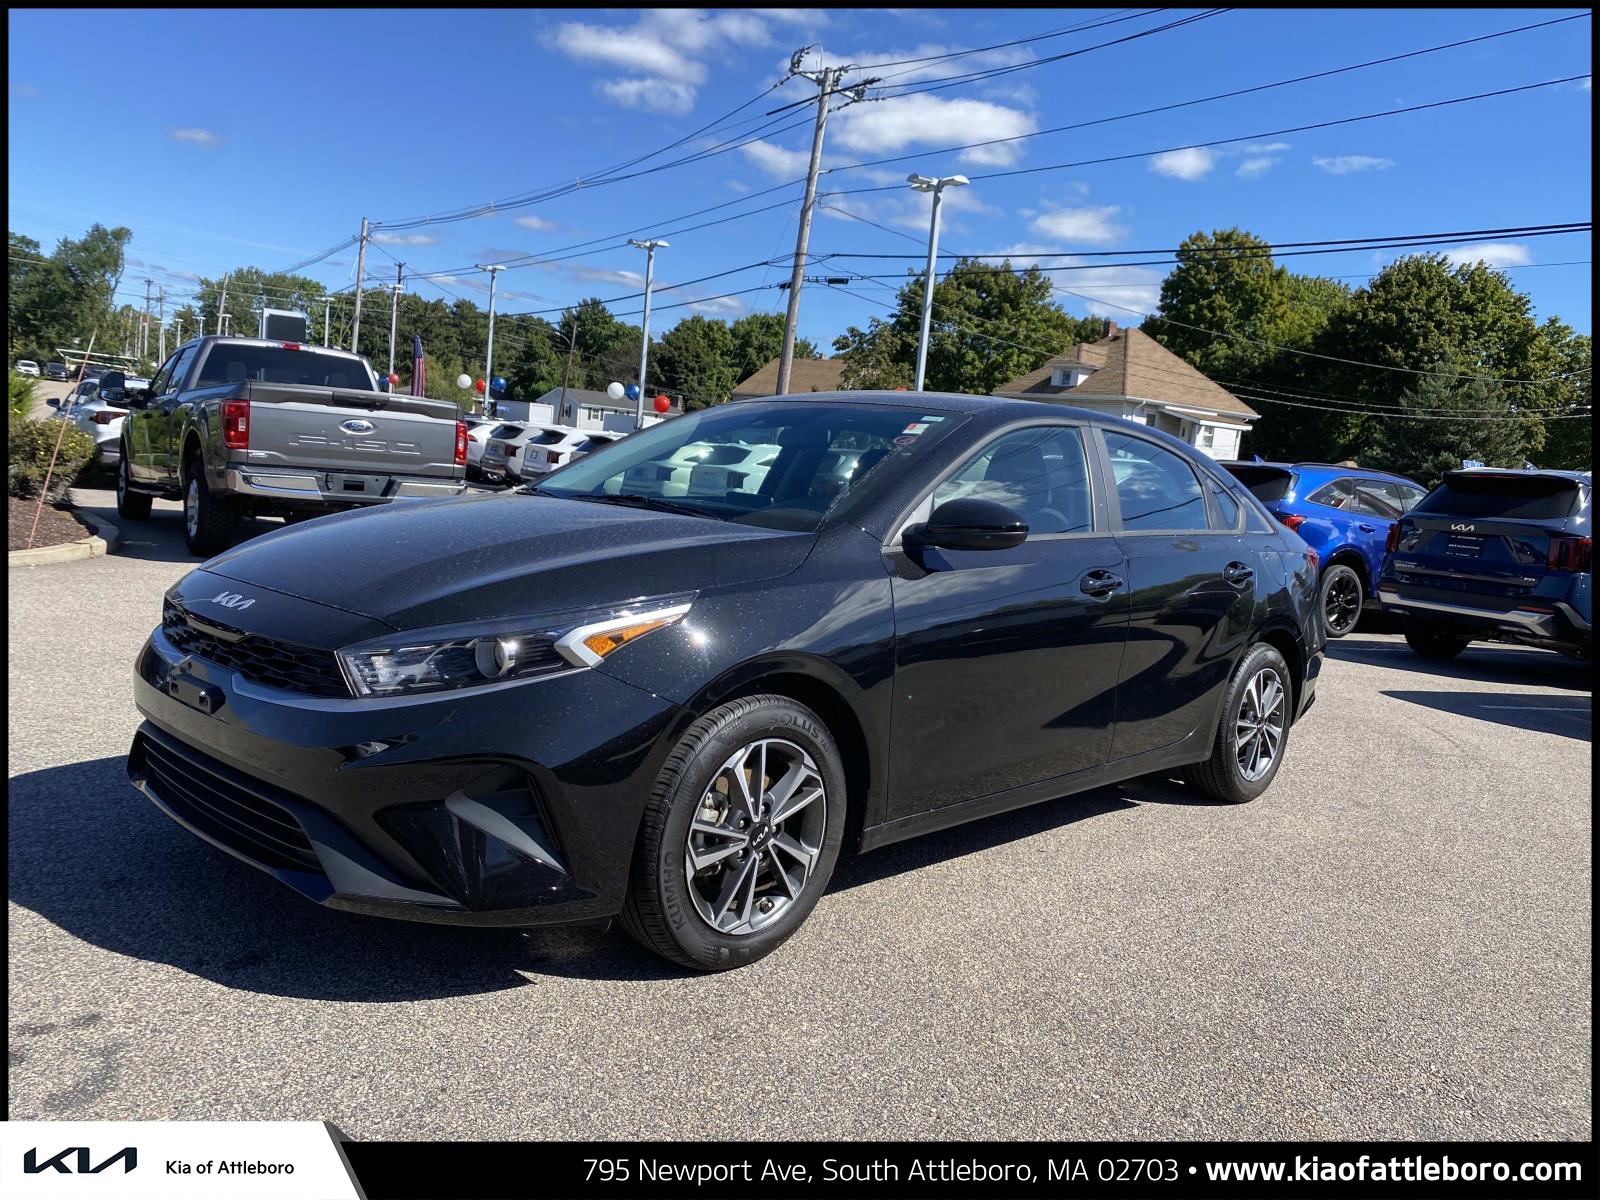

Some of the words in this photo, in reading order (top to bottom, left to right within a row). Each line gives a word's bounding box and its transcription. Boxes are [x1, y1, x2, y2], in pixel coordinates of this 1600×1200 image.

[1450, 523, 1475, 532] KIA
[211, 591, 256, 611] KIA
[768, 713, 821, 739] SOLUS
[664, 850, 687, 930] KUMHO
